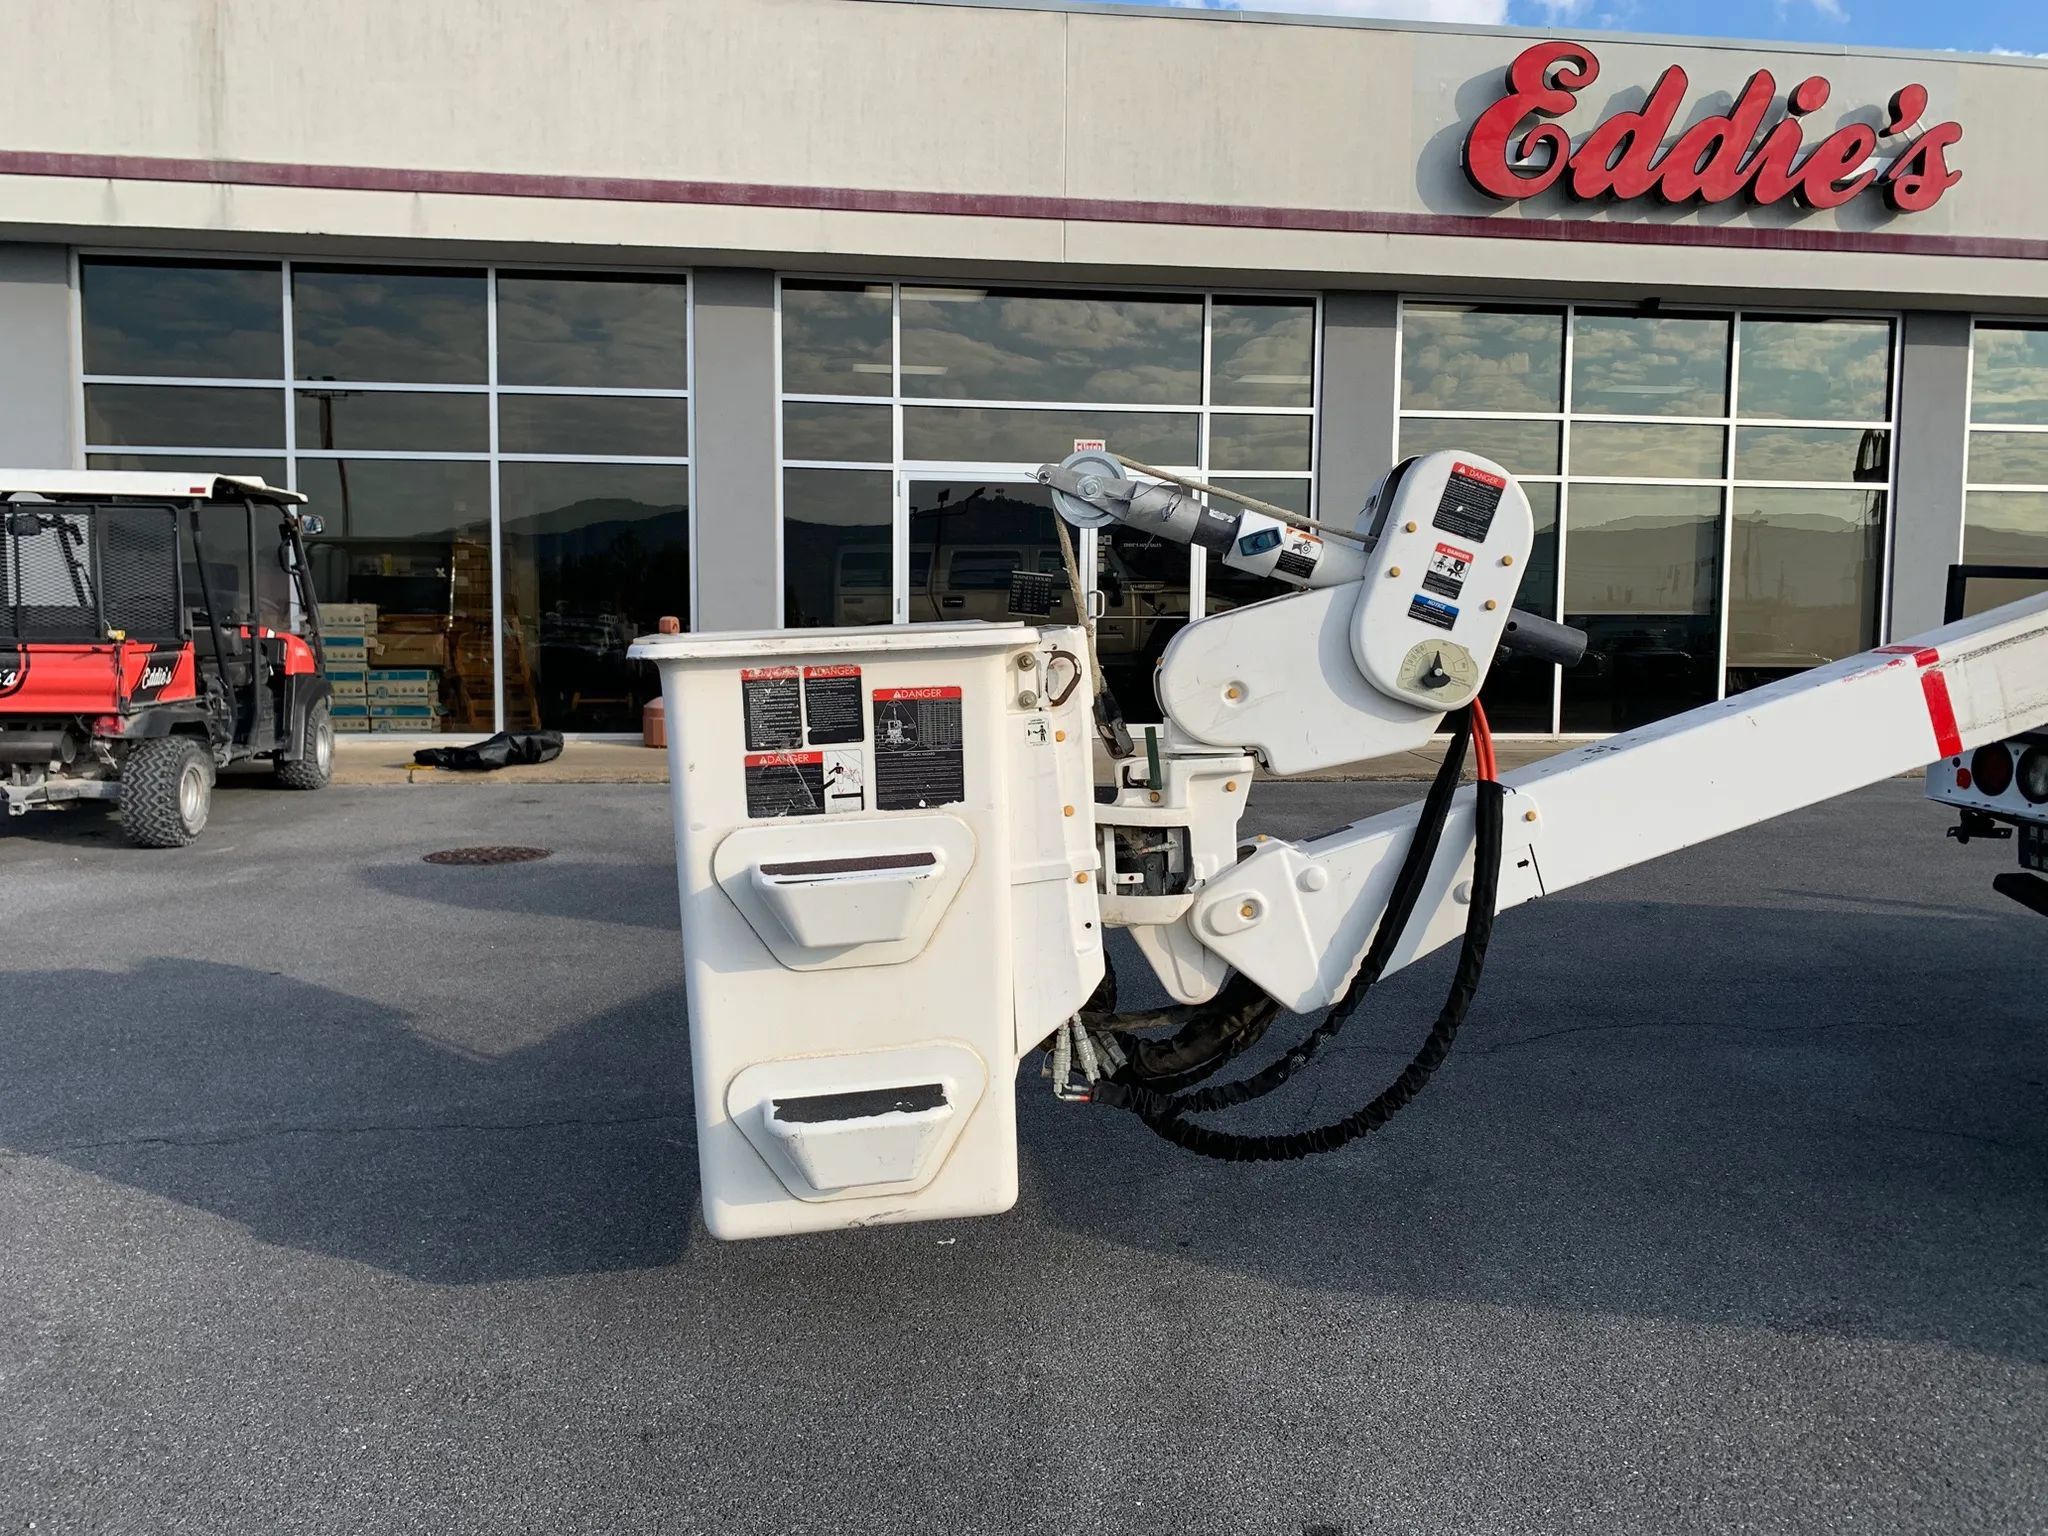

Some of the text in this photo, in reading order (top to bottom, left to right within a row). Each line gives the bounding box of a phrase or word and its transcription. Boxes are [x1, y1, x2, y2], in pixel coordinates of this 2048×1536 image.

[1464, 41, 1962, 211] Eddie's
[1468, 469, 1499, 484] DANGER
[1447, 548, 1470, 559] DANGER
[1427, 599, 1446, 610] NOTICE
[816, 666, 856, 676] DANGER
[141, 667, 172, 689] Eddie's
[901, 688, 942, 699] DANGER
[767, 753, 810, 763] DANGER
